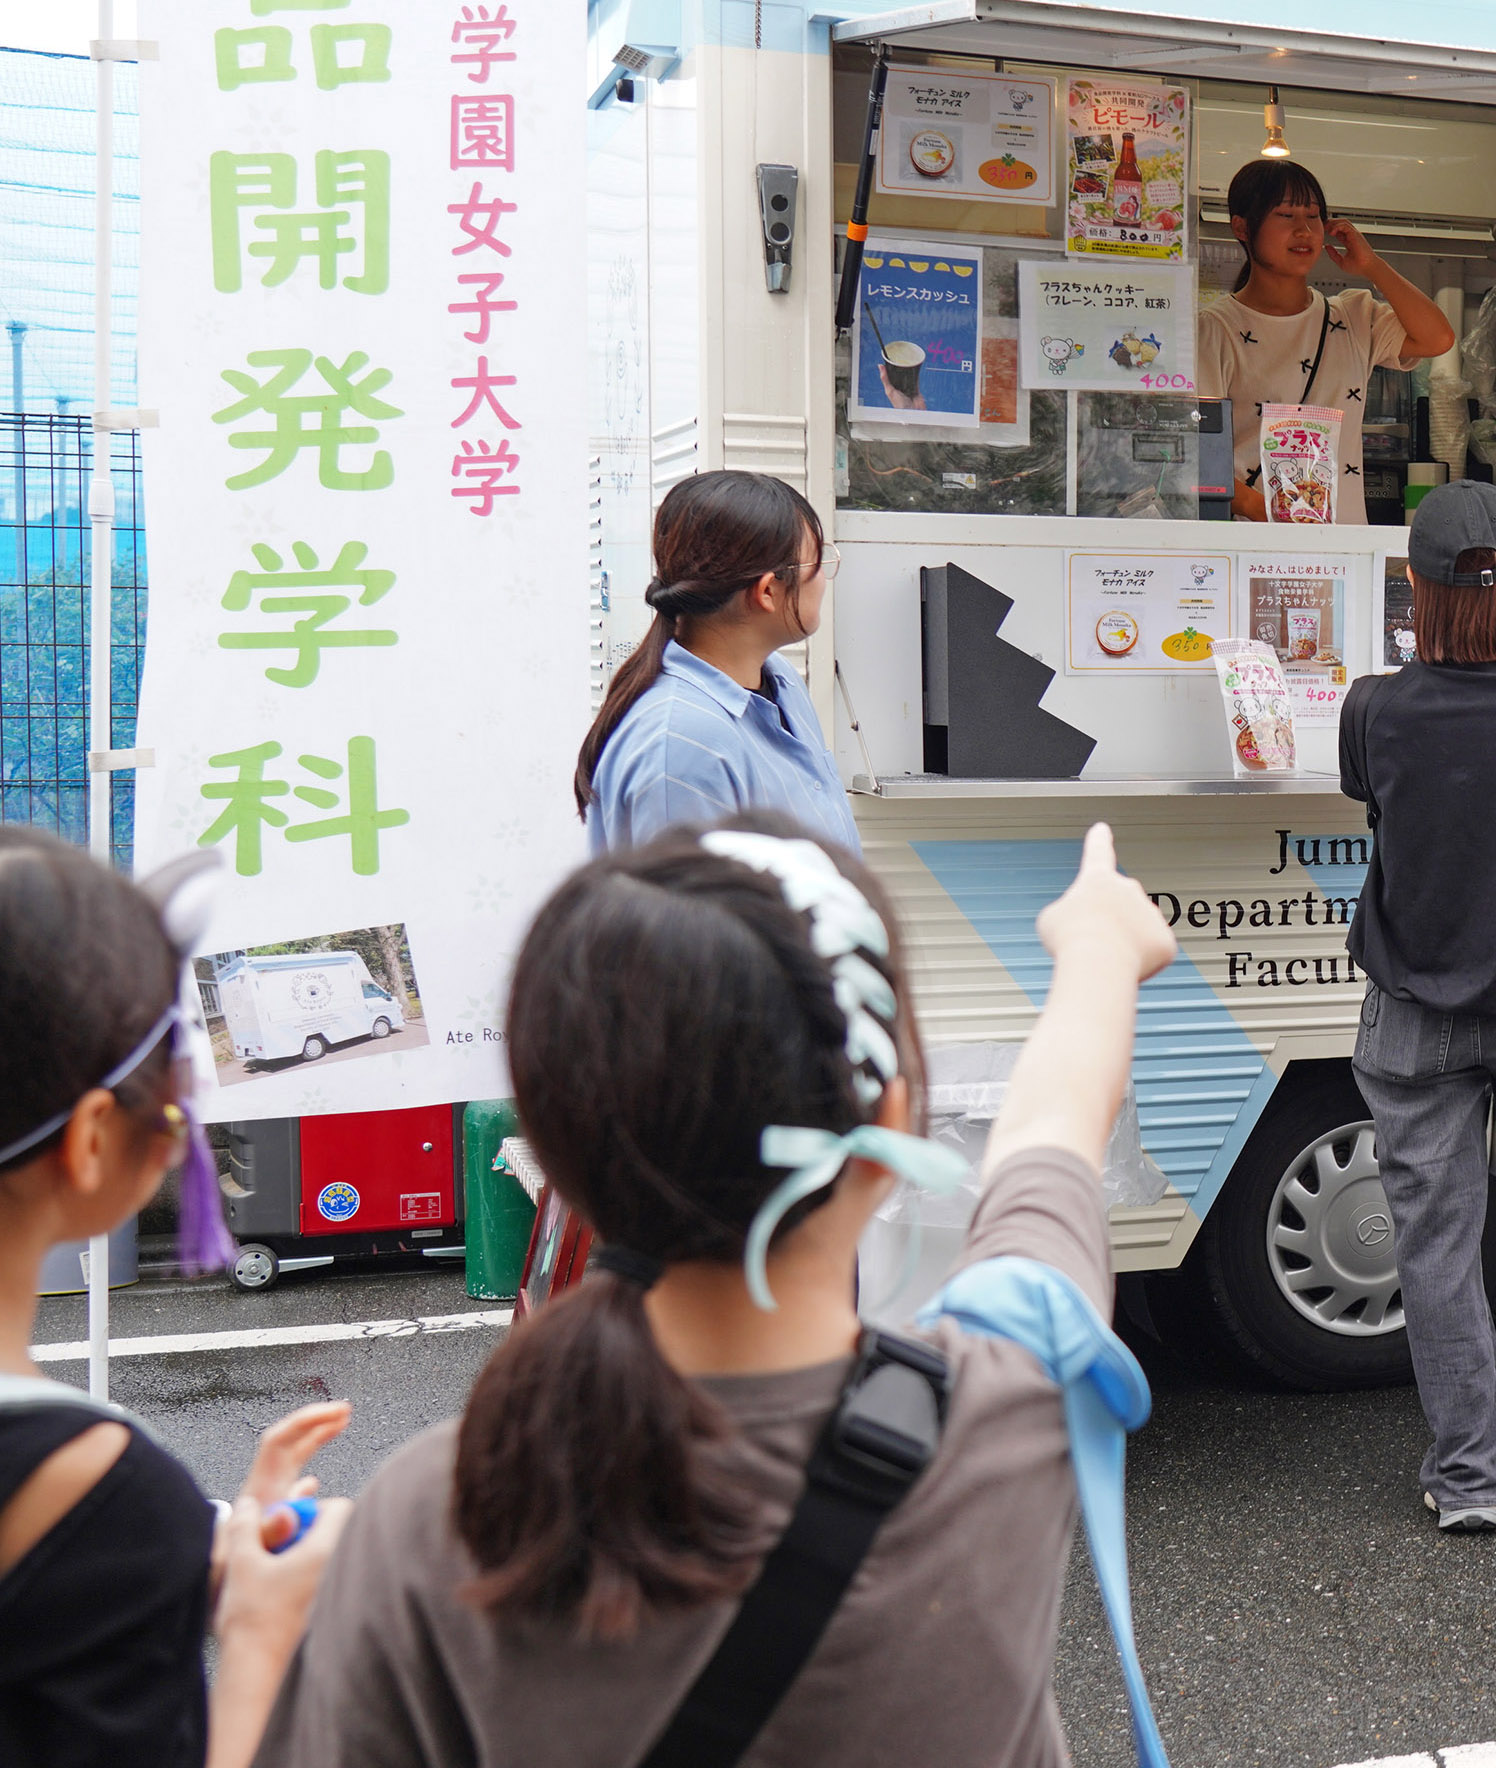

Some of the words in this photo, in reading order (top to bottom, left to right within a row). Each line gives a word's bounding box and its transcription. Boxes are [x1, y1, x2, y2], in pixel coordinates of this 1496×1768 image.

[949, 90, 970, 99] ミルク
[915, 96, 938, 105] モナカ
[942, 99, 962, 108] アイス
[1111, 97, 1145, 108] 共同開発
[1092, 106, 1166, 129] ピモール
[1024, 171, 1033, 180] 円
[446, 5, 523, 517] 学園女子大学
[867, 283, 971, 304] レモンスカッシュ
[1094, 569, 1132, 578] フォーチュン
[1133, 570, 1155, 578] ミルク
[1101, 578, 1123, 587] モナカ
[1126, 578, 1146, 587] アイス
[1256, 595, 1336, 607] プラスちゃんナッツ
[1305, 687, 1337, 702] 400
[1147, 891, 1359, 940] Departm
[1224, 950, 1359, 988] Facul
[446, 1030, 474, 1045] Ate
